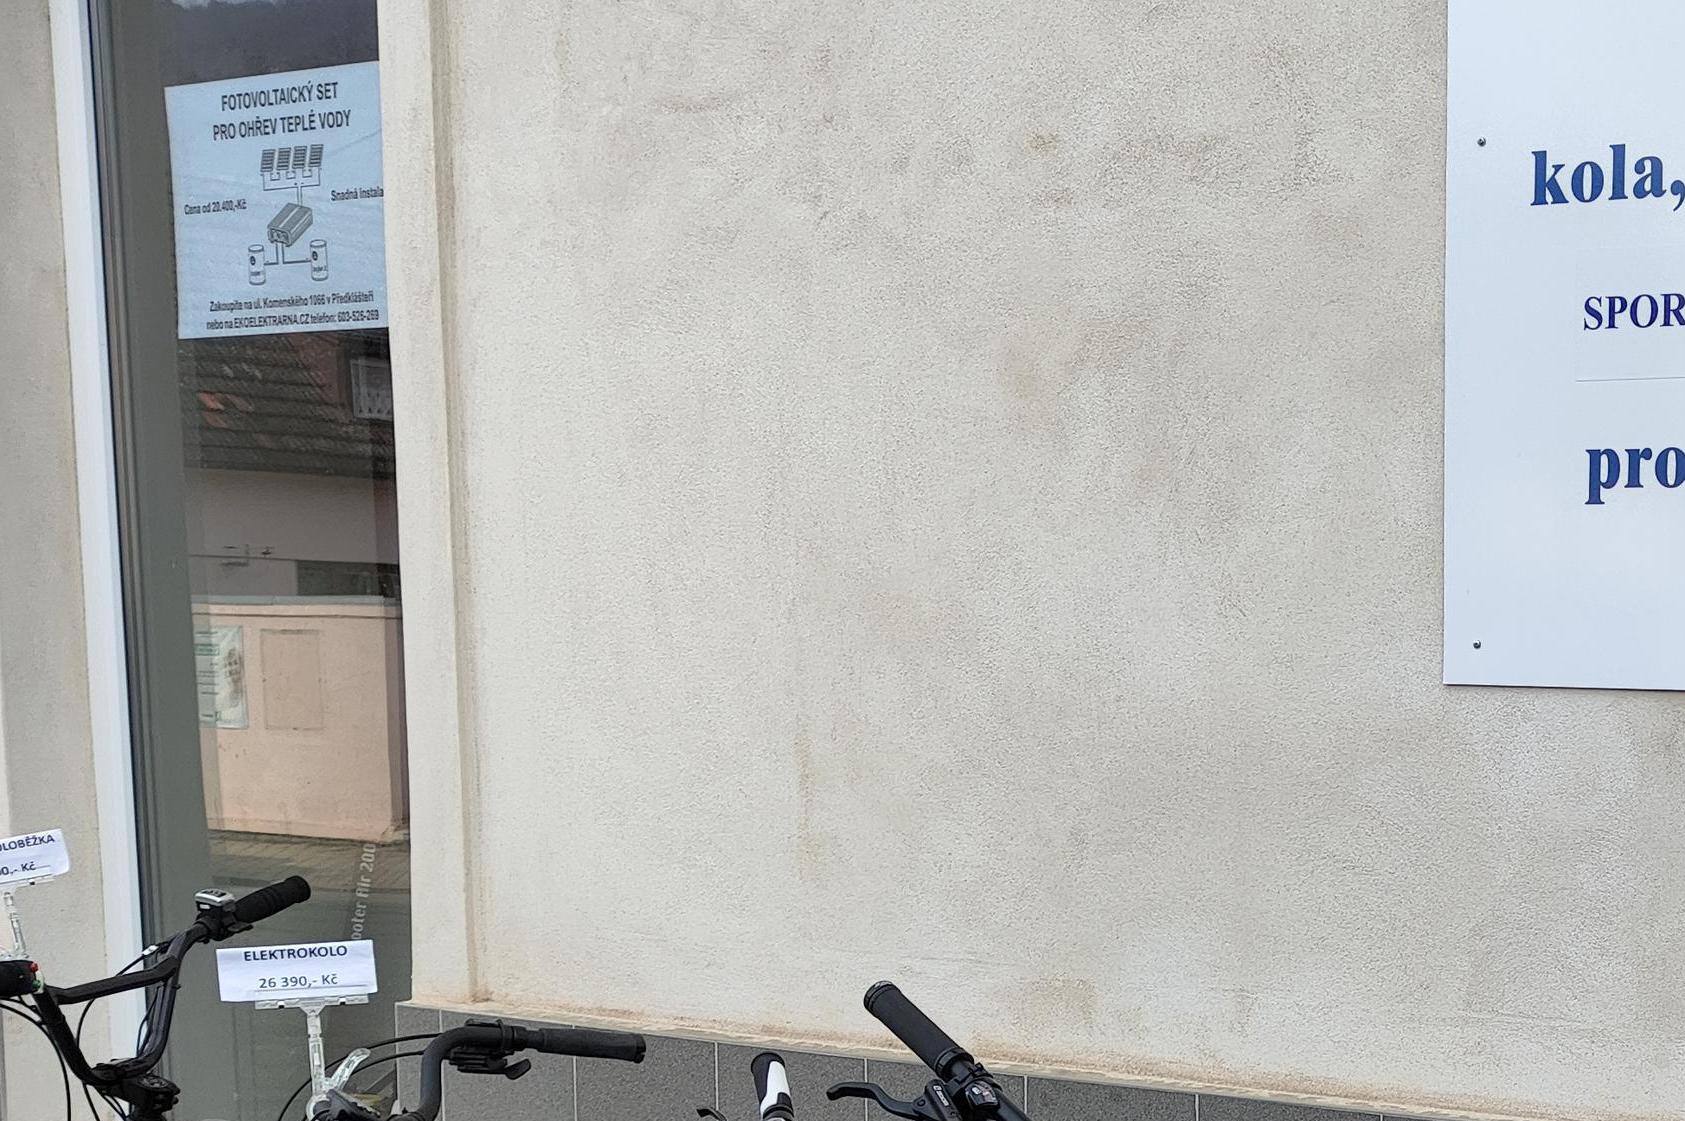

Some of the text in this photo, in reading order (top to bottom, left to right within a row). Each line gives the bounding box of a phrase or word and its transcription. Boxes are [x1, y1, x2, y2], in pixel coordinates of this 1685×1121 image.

[221, 81, 339, 111] FOTOVOLTAICKÝ SET
[213, 109, 352, 141] PRO OHŘEV TEPLÉ VODY
[202, 202, 212, 213] od
[0, 834, 55, 852] LOBĚŽKA
[0, 861, 36, 877] 0,- Kč
[244, 945, 348, 962] ELEKTROKOLO
[258, 973, 338, 989] 26 390,- Kč
